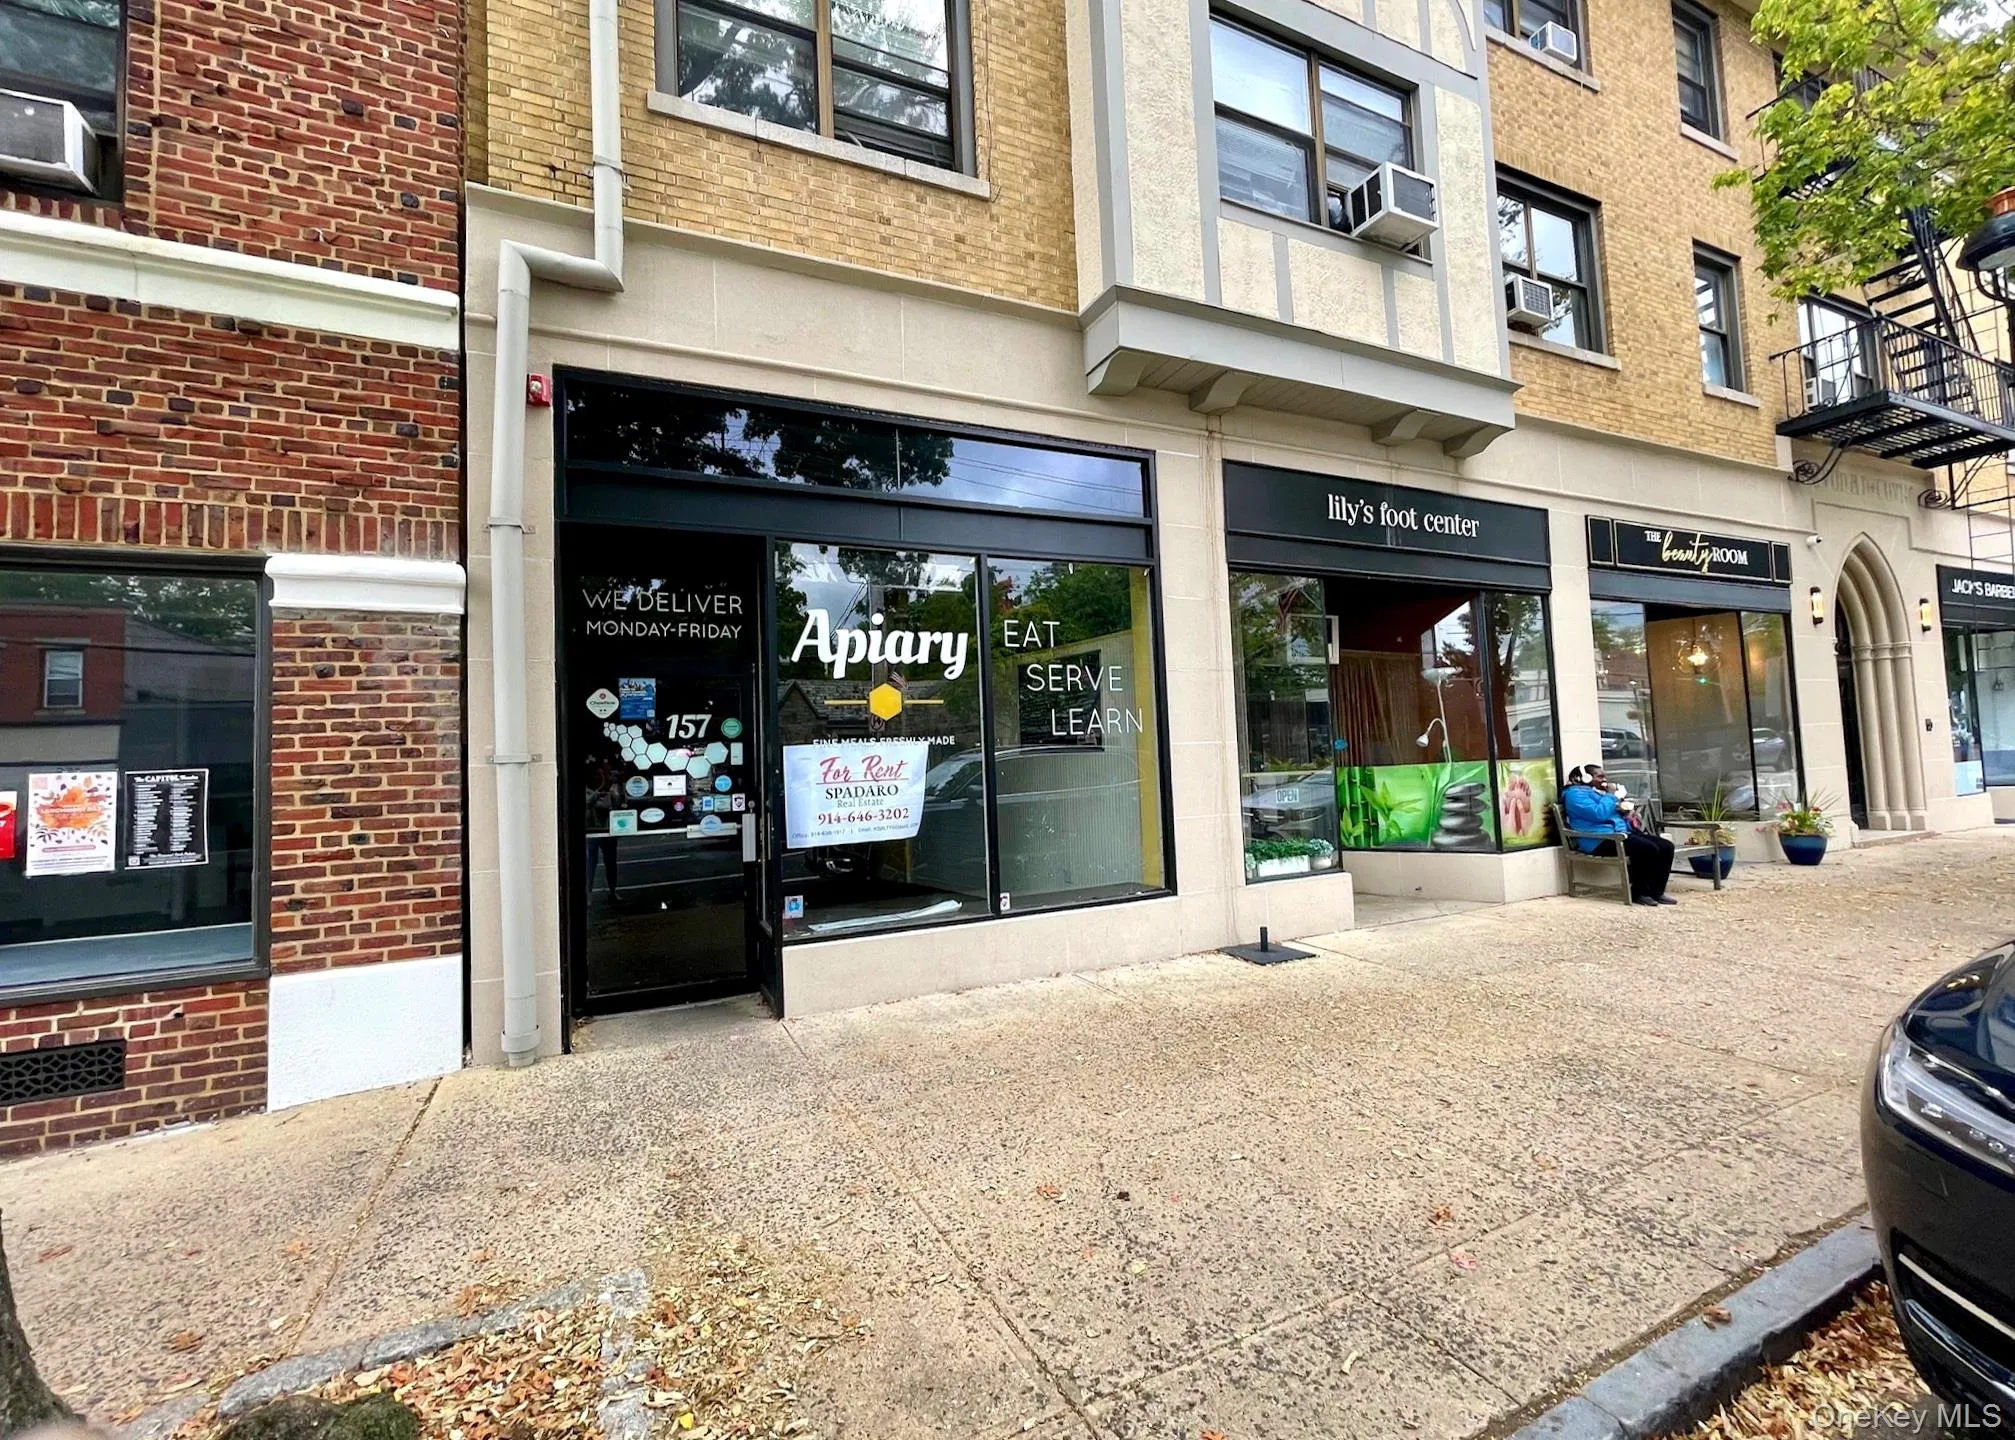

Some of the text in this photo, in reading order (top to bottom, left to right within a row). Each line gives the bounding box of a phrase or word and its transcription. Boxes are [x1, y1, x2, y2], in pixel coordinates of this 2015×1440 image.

[1327, 493, 1480, 538] lily's foot center
[1644, 530, 1662, 543] THE
[1661, 530, 1749, 574] beauty ROOM
[582, 588, 743, 615] WE DELIVER
[586, 619, 743, 639] MONDAY-FRIDAY
[1003, 619, 1061, 648] EAT
[790, 608, 969, 681] Apiary
[1026, 663, 1124, 692] SERVE
[666, 714, 712, 739] 157
[1051, 708, 1144, 736] LEARN
[927, 735, 956, 746] MADE
[819, 754, 909, 784] For Rent
[825, 784, 899, 801] SPADARO
[837, 797, 885, 808] Real Estate
[1276, 789, 1298, 802] OPEN
[818, 808, 910, 826] 914-646-3202
